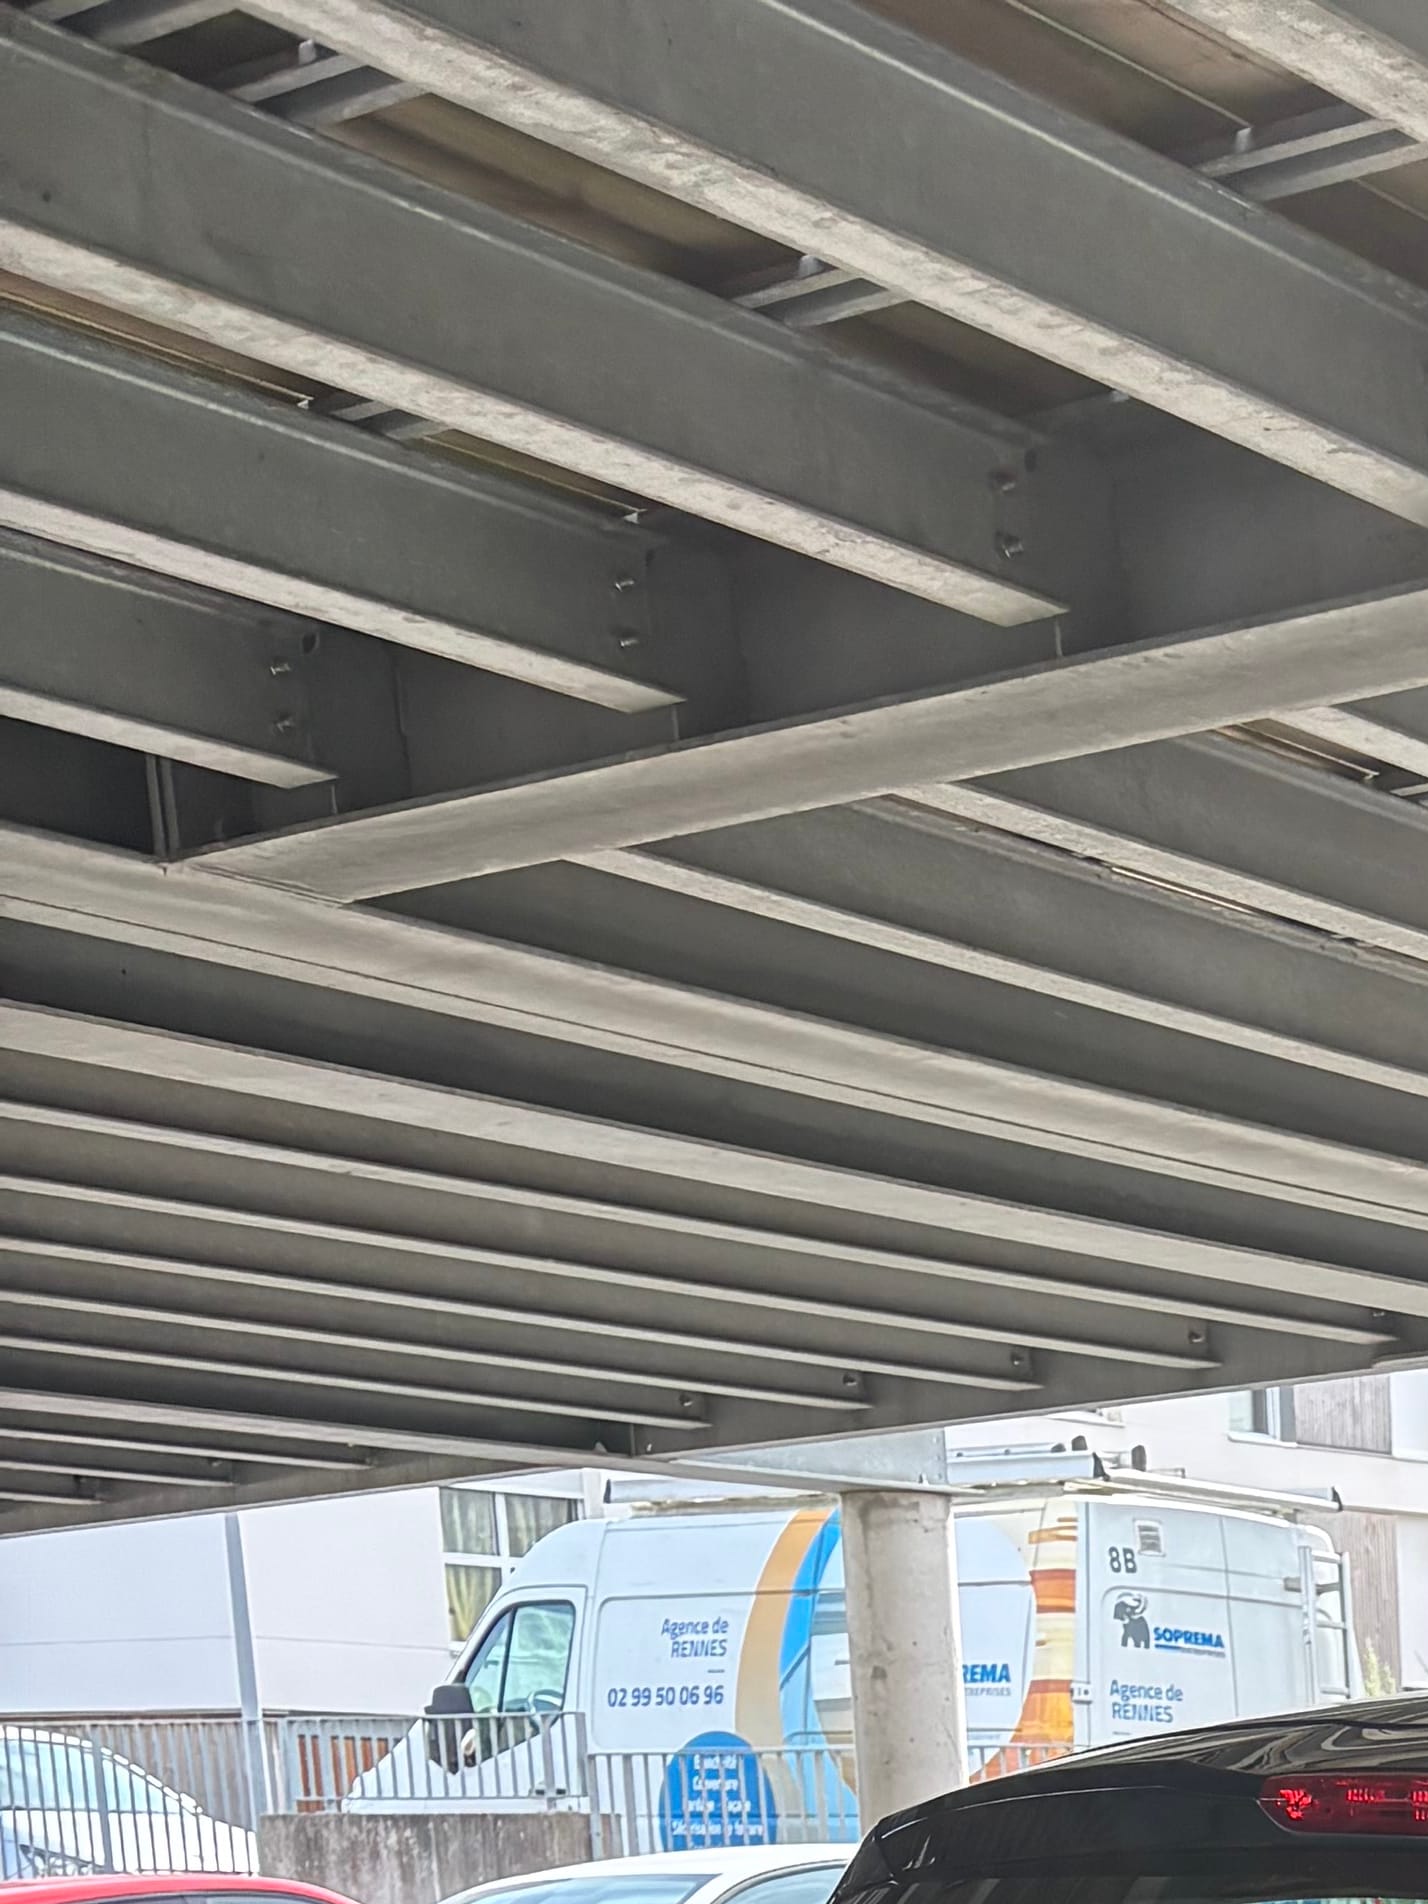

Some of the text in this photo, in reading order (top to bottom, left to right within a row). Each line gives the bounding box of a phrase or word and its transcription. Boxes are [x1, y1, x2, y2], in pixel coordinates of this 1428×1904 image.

[1108, 1546, 1137, 1574] 8B
[661, 1616, 729, 1640] Agence de
[1153, 1626, 1225, 1649] SOPREMA
[671, 1639, 727, 1658] RENNES
[608, 1685, 724, 1707] 02 99 50 06 96
[1110, 1679, 1184, 1702] Agence de
[1112, 1702, 1174, 1723] RENNES
